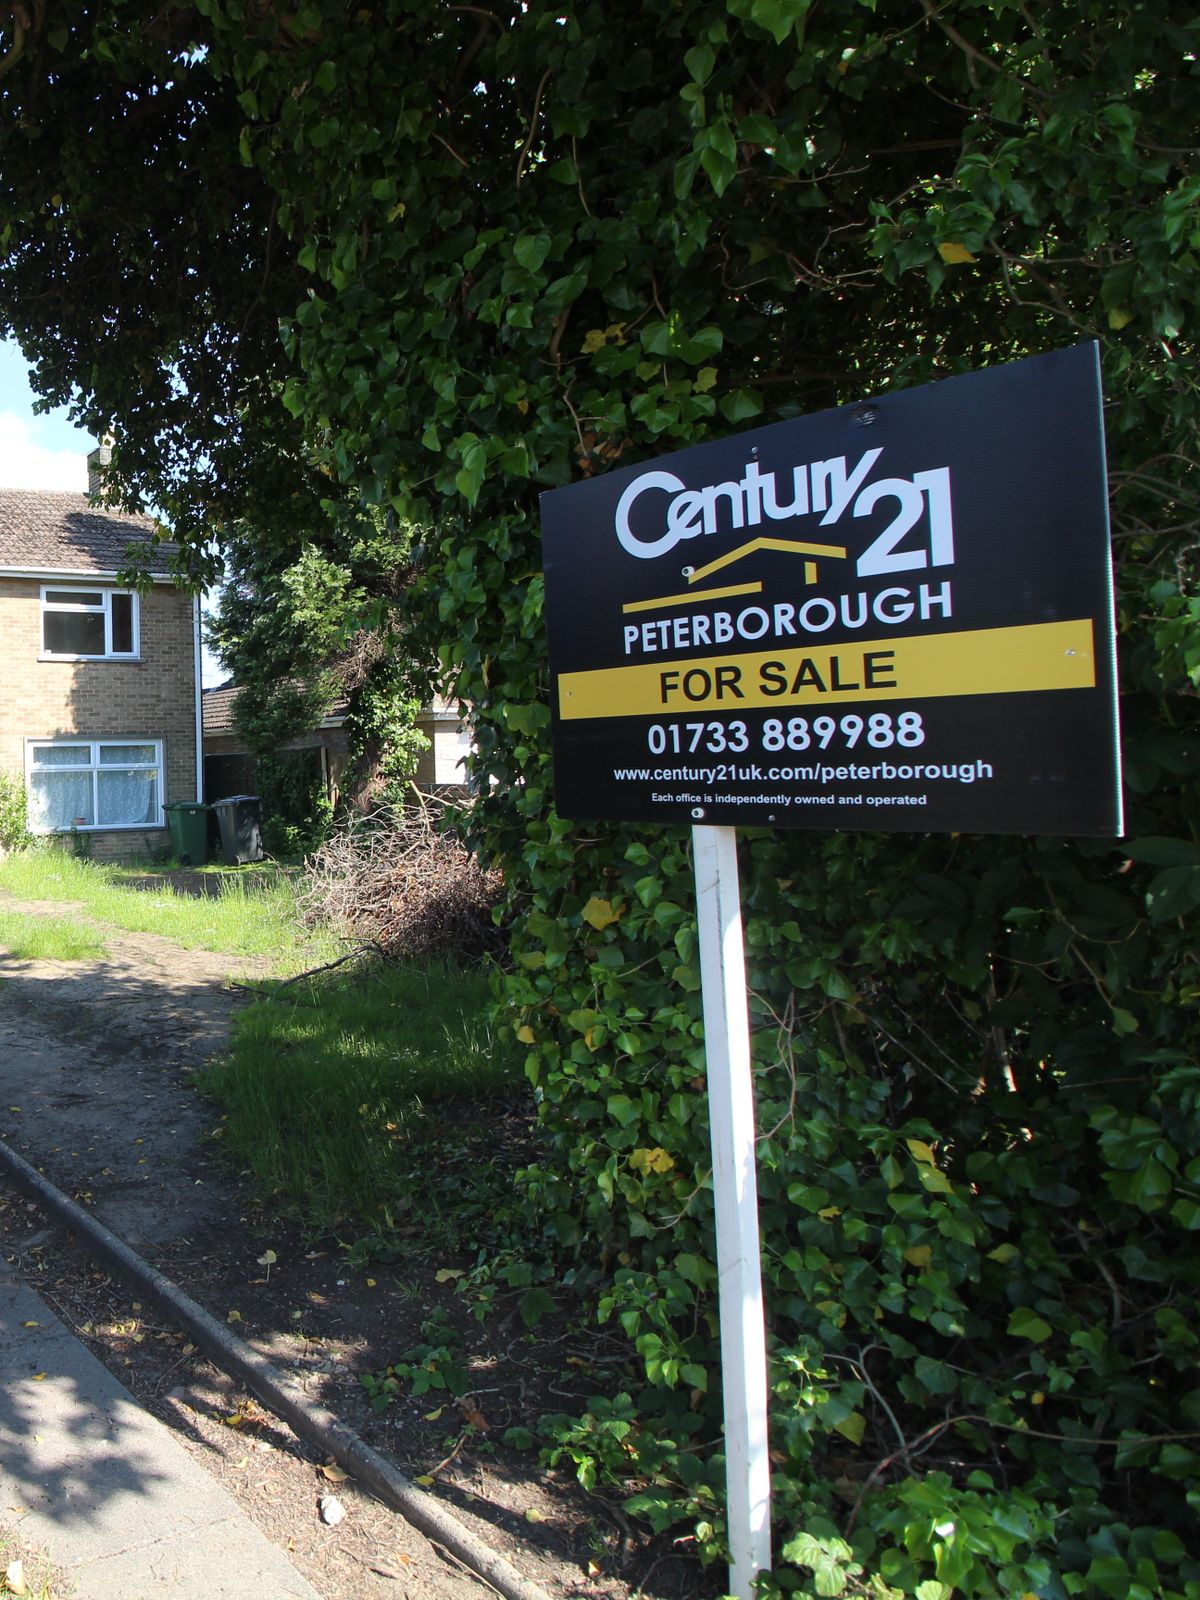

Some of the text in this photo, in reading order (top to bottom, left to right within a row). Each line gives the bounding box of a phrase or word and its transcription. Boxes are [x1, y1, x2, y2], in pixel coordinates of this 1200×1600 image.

[615, 447, 955, 577] Century 21
[623, 581, 952, 654] PETERBOROUGH
[660, 650, 898, 703] FOR SALE
[647, 711, 926, 755] 01733 889988
[614, 760, 994, 783] www.century21uk.com/peterborough
[651, 792, 928, 806] Each office is independently owned and operated
